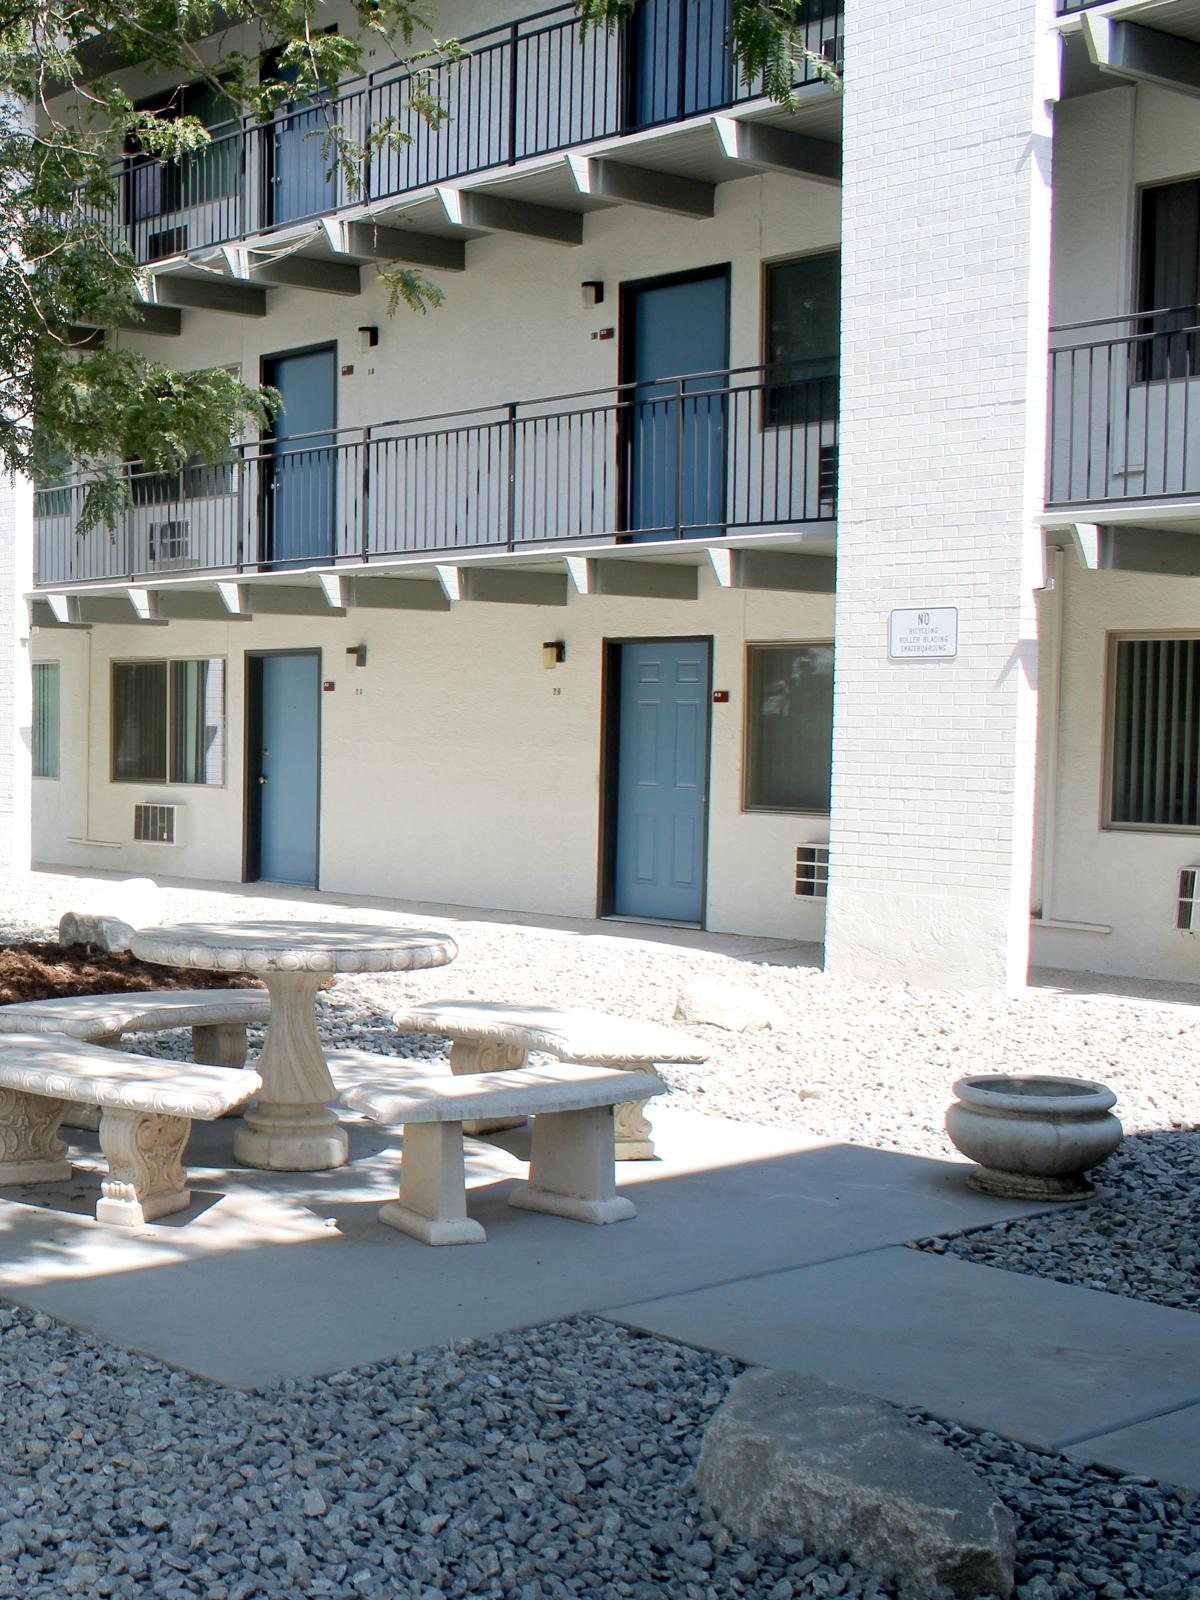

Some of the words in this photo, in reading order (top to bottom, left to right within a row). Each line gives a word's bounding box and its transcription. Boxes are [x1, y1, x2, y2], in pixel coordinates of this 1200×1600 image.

[918, 612, 929, 625] NO
[908, 627, 938, 635] BICYCLING
[923, 635, 948, 643] BLADING
